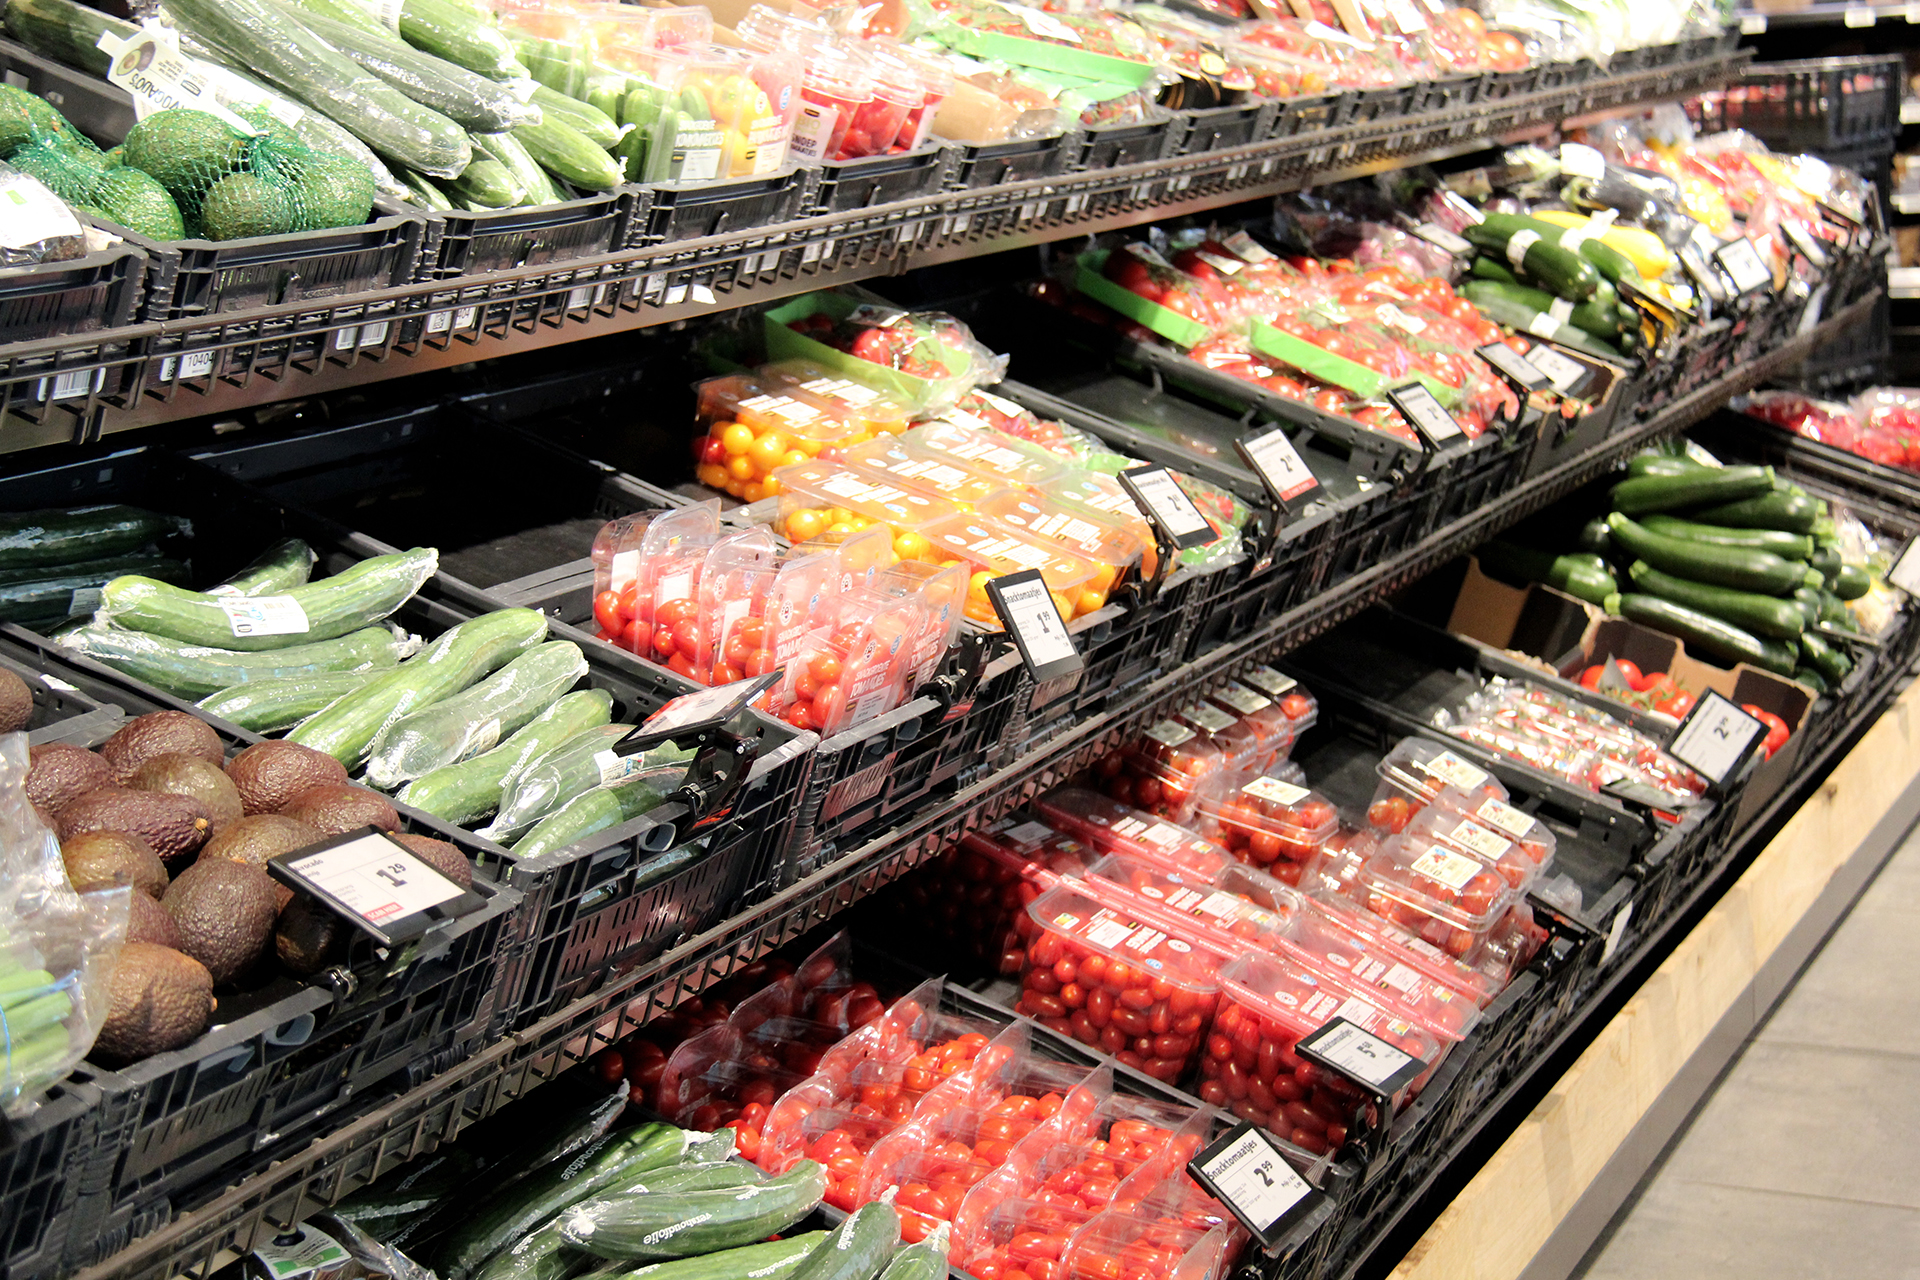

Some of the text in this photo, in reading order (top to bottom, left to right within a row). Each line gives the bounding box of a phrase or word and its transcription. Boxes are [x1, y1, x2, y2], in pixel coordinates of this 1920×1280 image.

[1713, 726, 1730, 740] 2
[375, 862, 408, 888] 1 29
[366, 902, 403, 921] SCAN HIER
[1356, 1045, 1376, 1059] 5
[1207, 1139, 1258, 1180] Snacktomaatjes
[1253, 1160, 1275, 1188] 2 99
[643, 1211, 714, 1246] vershoudfolie
